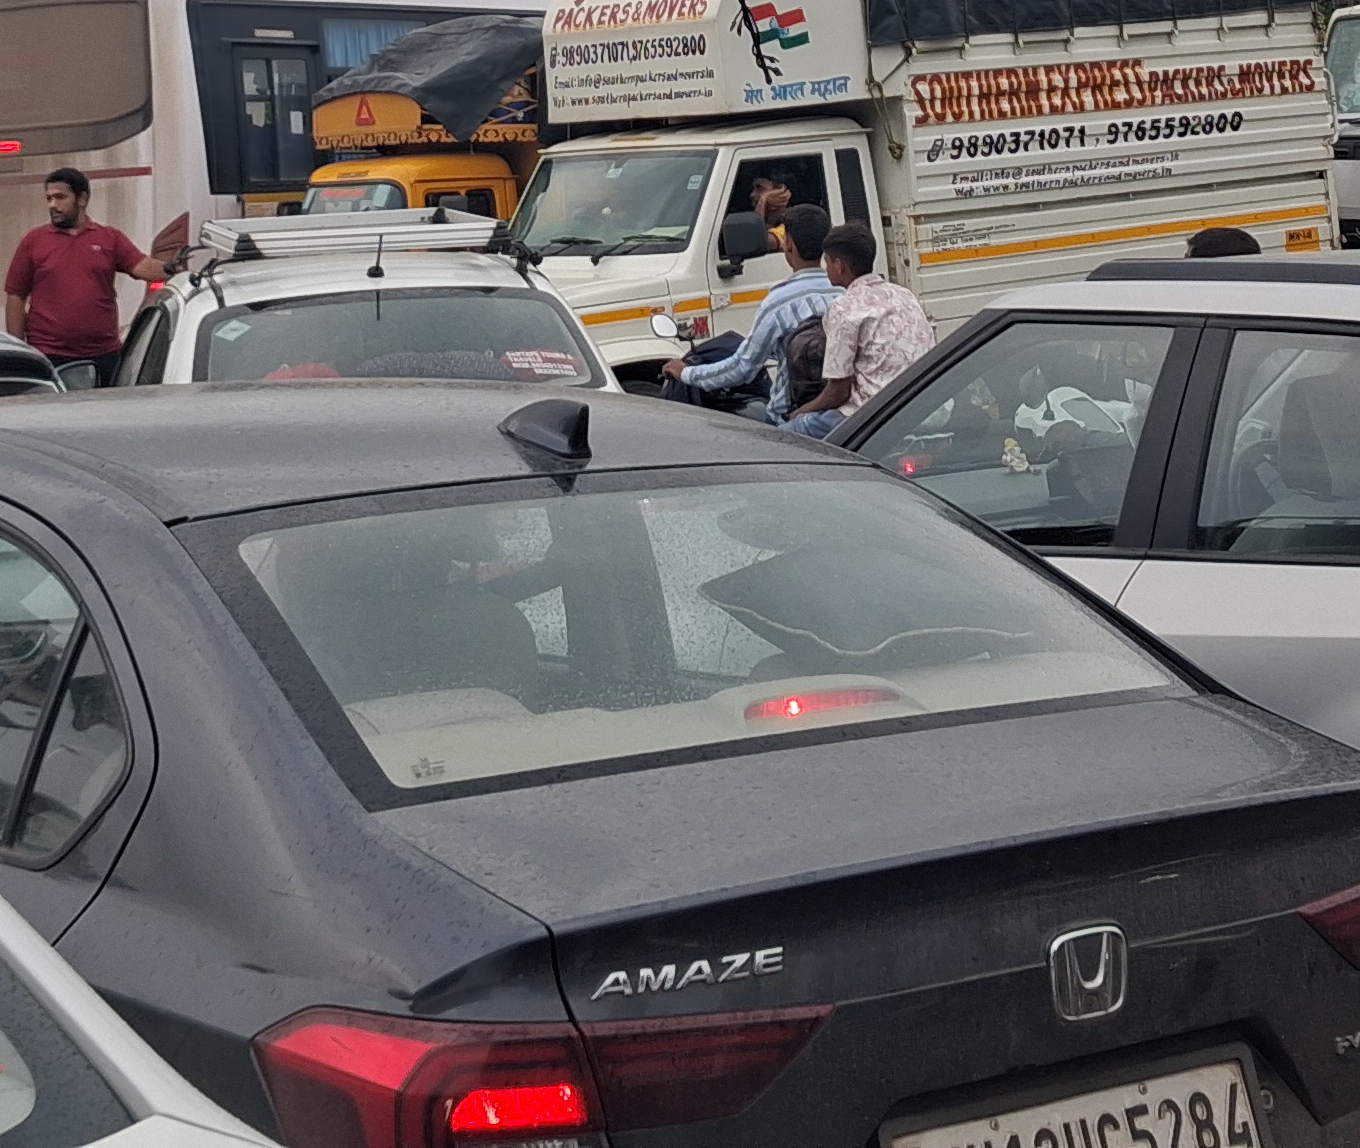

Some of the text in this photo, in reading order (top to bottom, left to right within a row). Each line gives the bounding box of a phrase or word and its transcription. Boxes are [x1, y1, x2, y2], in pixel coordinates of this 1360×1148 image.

[743, 75, 851, 105] मेरा भारत महान
[1106, 111, 1244, 146] 9765592800
[590, 946, 784, 1001] AMAZE
